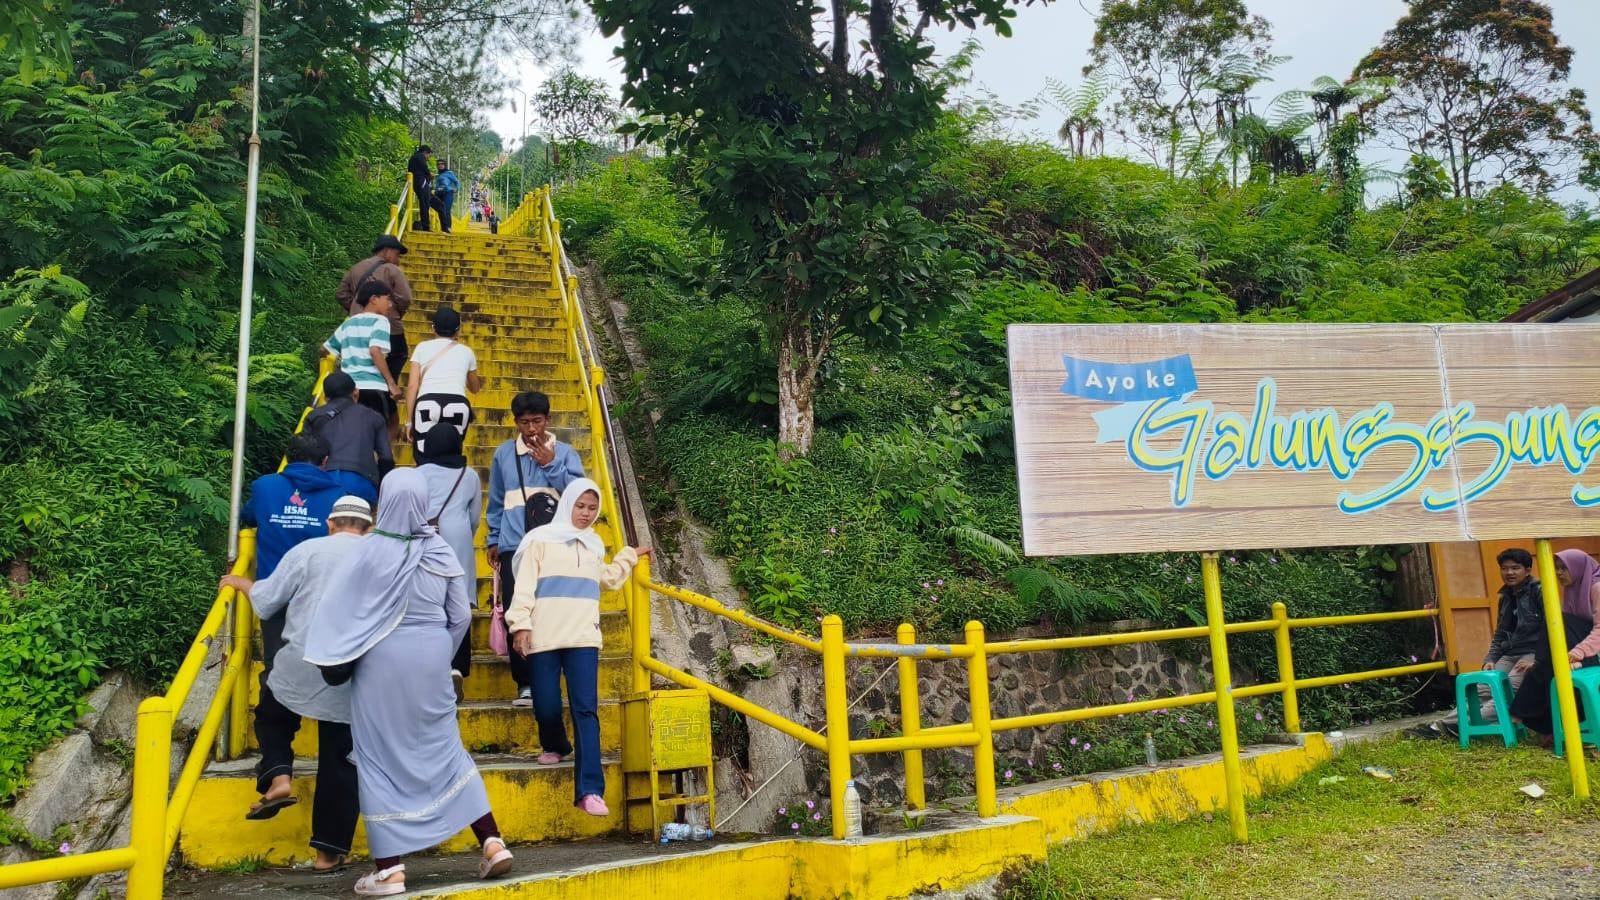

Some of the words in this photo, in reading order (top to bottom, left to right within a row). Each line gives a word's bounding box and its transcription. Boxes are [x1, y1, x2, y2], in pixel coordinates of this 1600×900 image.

[1085, 369, 1136, 394] Ayo
[1146, 369, 1176, 389] ke
[1128, 377, 1600, 513] Galunggun
[283, 505, 308, 516] HSM
